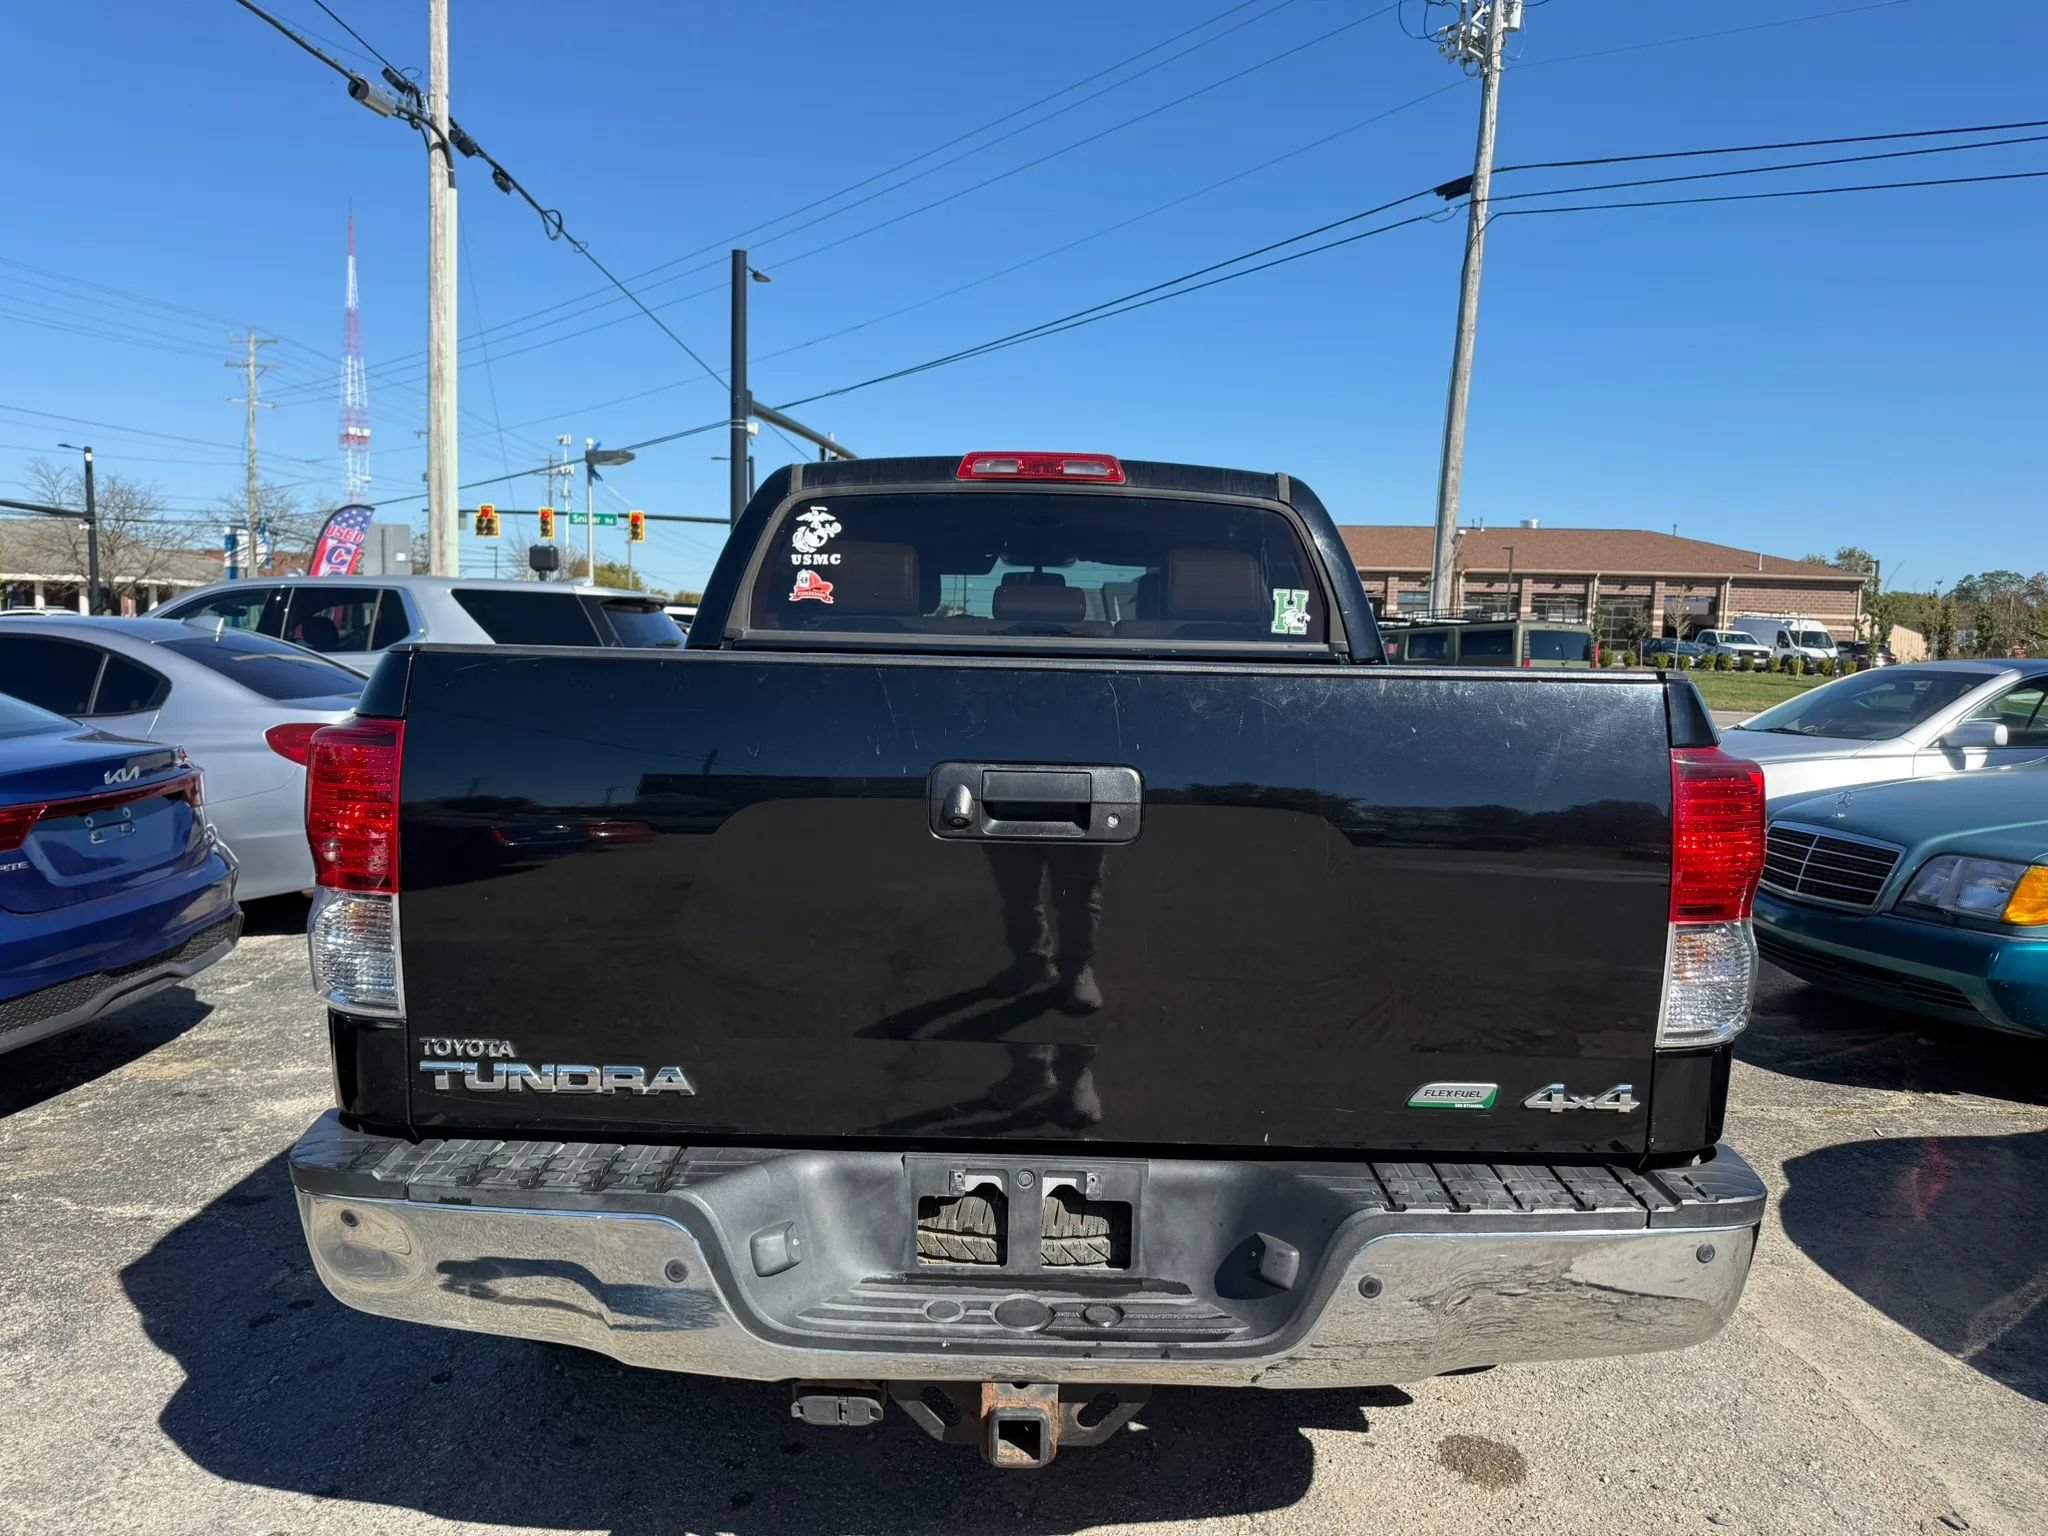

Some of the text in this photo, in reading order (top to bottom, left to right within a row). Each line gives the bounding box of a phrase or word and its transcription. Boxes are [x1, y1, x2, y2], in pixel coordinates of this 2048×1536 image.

[573, 514, 601, 524] Snier
[326, 524, 364, 544] USED
[791, 553, 841, 565] USMC
[104, 765, 140, 785] KIA
[419, 1037, 516, 1058] TOYOTA
[419, 1060, 696, 1096] TUNDRA
[1523, 1083, 1641, 1113] 4x4
